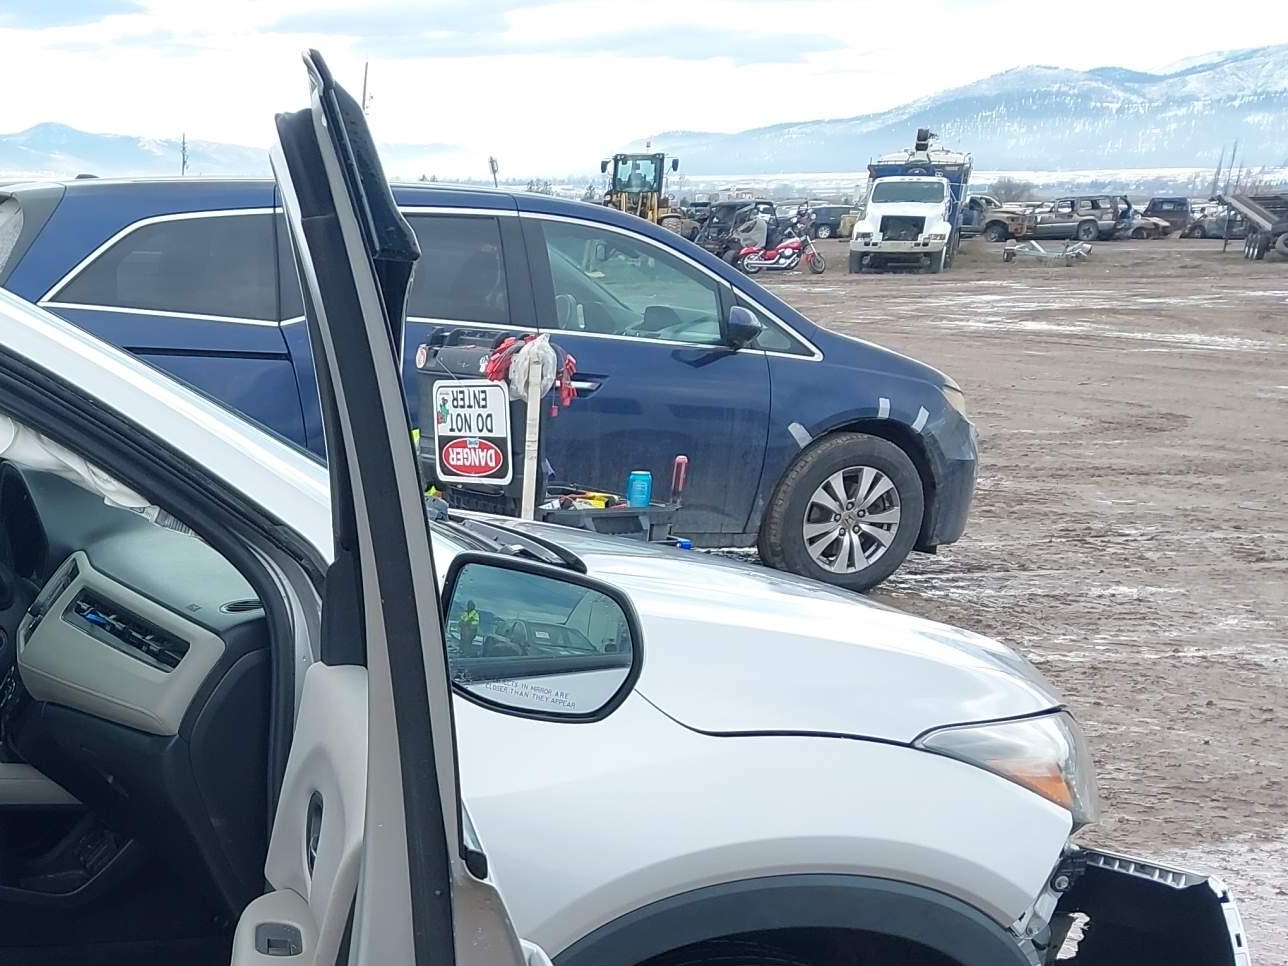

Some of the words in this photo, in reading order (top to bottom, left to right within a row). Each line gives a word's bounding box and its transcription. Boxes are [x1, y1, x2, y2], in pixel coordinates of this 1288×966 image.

[451, 389, 487, 409] ENTER
[449, 413, 472, 433] NOT
[476, 413, 494, 433] DO
[449, 448, 495, 467] DANGER
[486, 684, 508, 695] CLOSER
[510, 688, 529, 698] THAN
[532, 693, 549, 702] THEY
[551, 699, 576, 709] APPEAR
[531, 686, 552, 696] MIRROR
[555, 691, 569, 700] ARE
